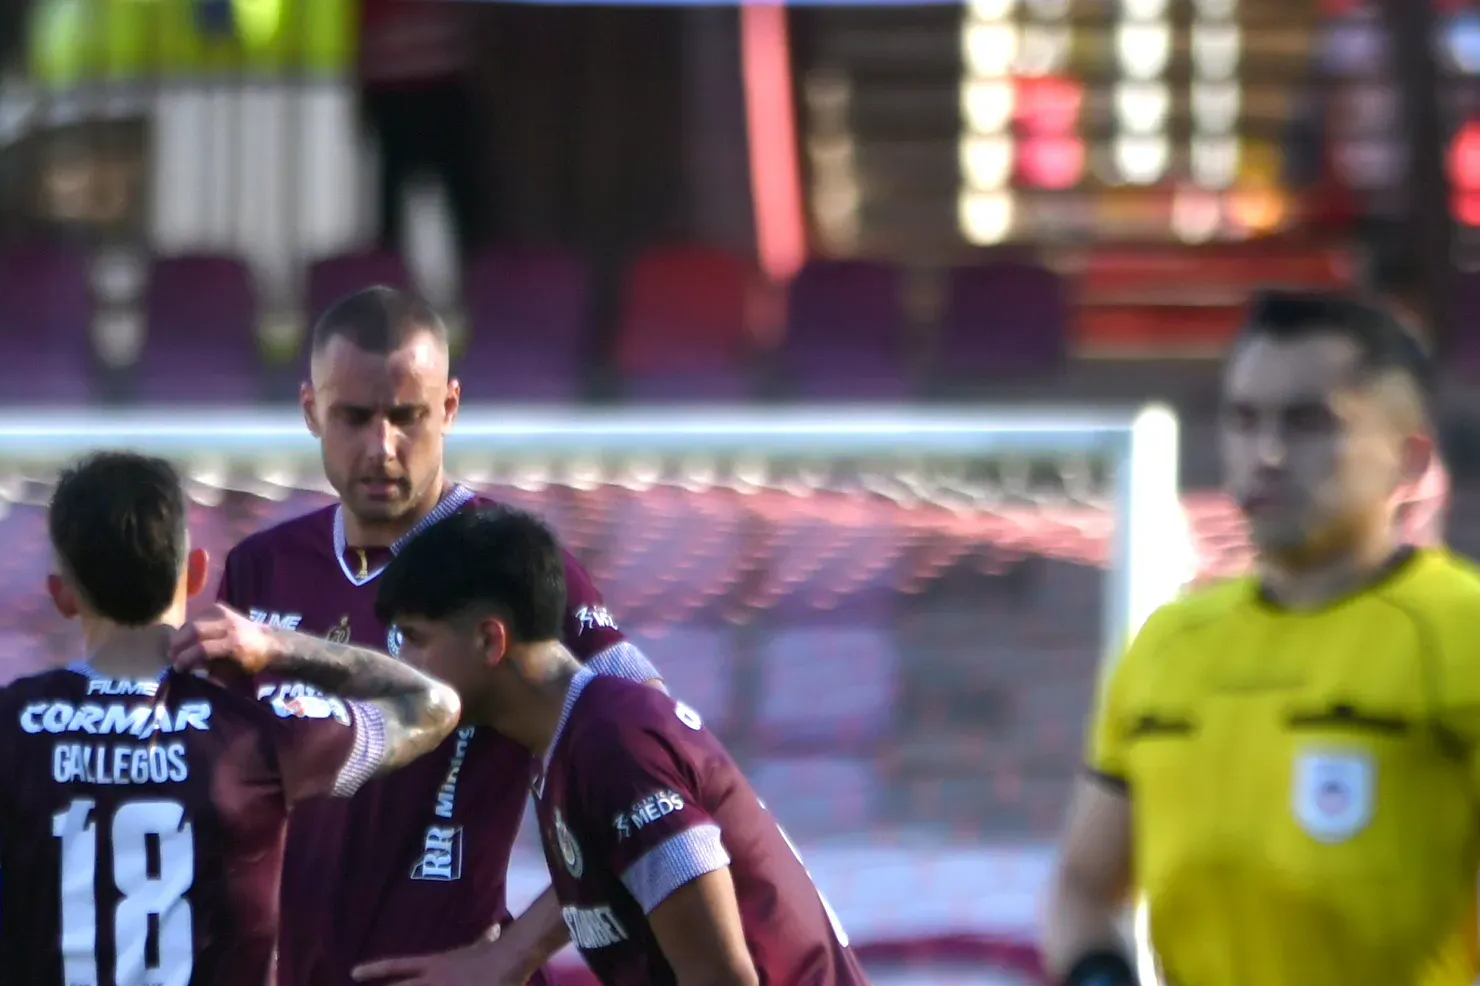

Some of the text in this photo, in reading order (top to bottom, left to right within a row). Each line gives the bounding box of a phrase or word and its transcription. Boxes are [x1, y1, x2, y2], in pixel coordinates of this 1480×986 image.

[87, 679, 159, 696] FIUME
[20, 702, 211, 740] CORMAR
[53, 743, 188, 784] GALLEGOS
[435, 726, 475, 819] Mining
[631, 793, 683, 830] MEDS
